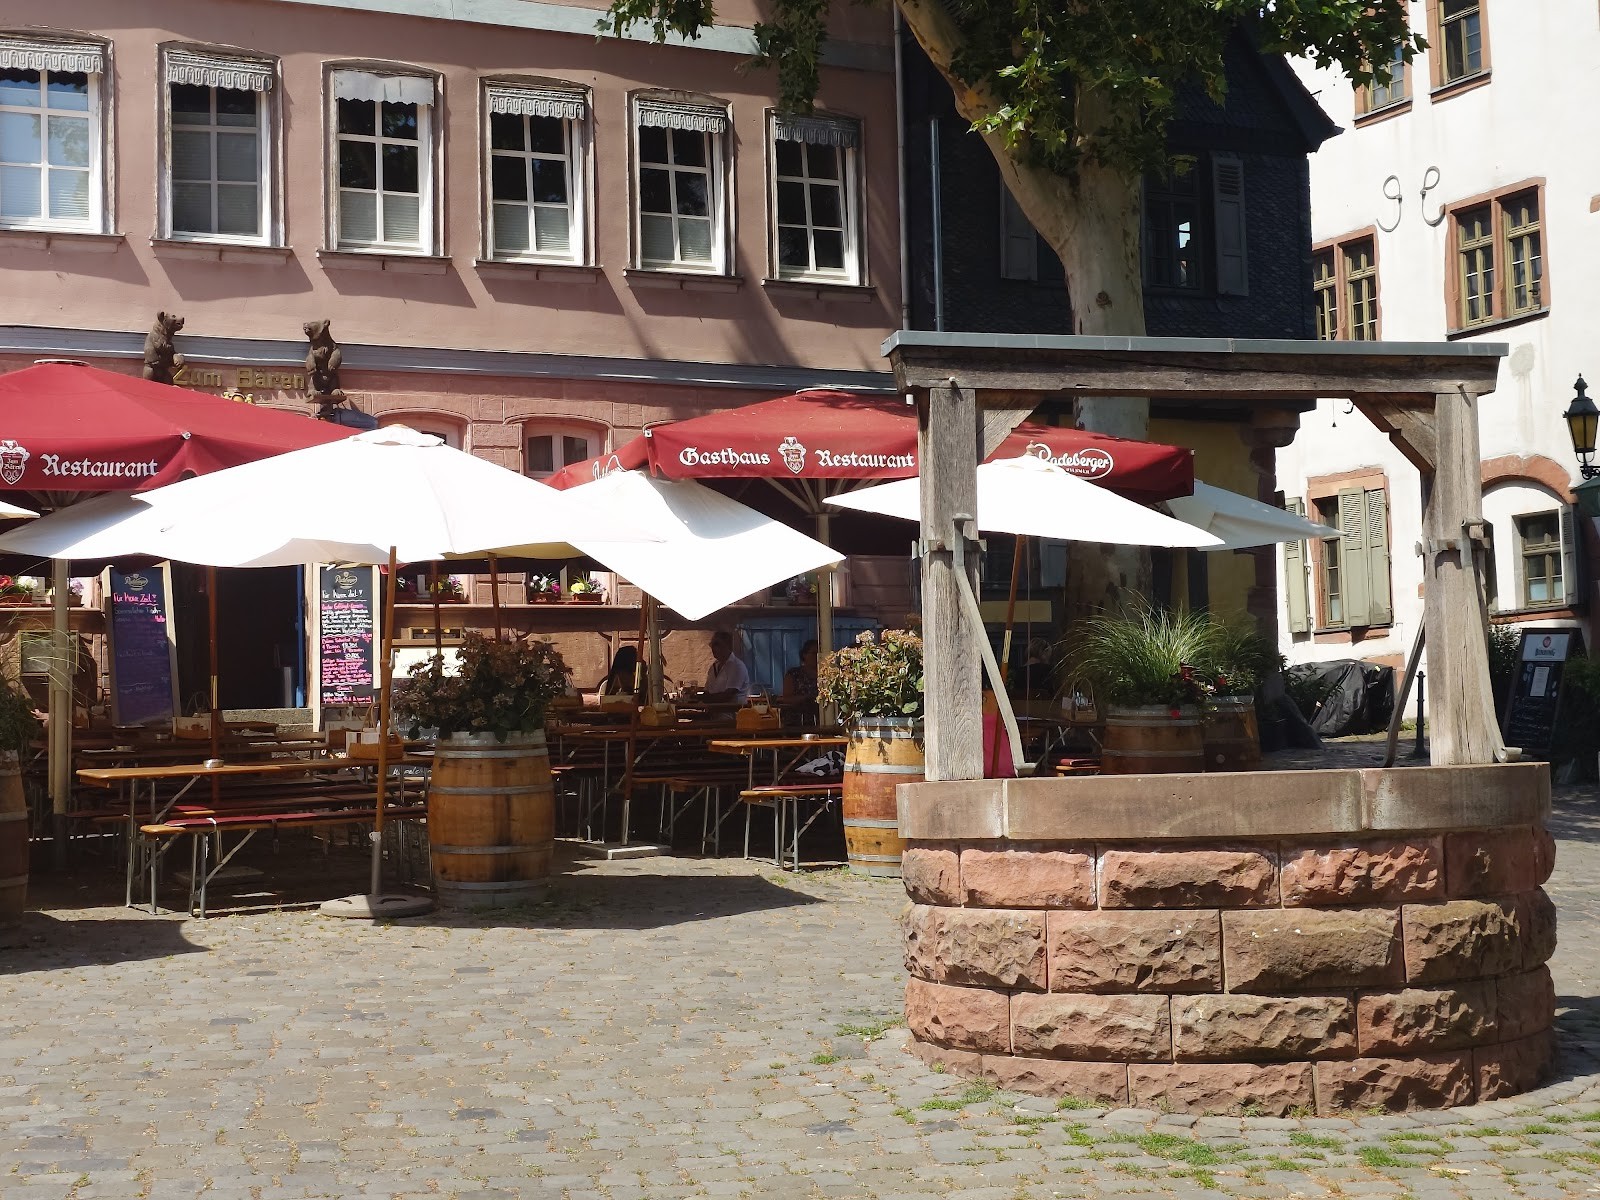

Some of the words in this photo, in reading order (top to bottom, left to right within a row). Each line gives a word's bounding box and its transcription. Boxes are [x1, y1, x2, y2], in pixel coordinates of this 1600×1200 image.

[172, 364, 222, 388] Zum
[236, 367, 305, 390] Bären
[40, 453, 160, 478] Restaurant
[679, 447, 771, 469] Gasthaus
[815, 449, 915, 468] Restaurant
